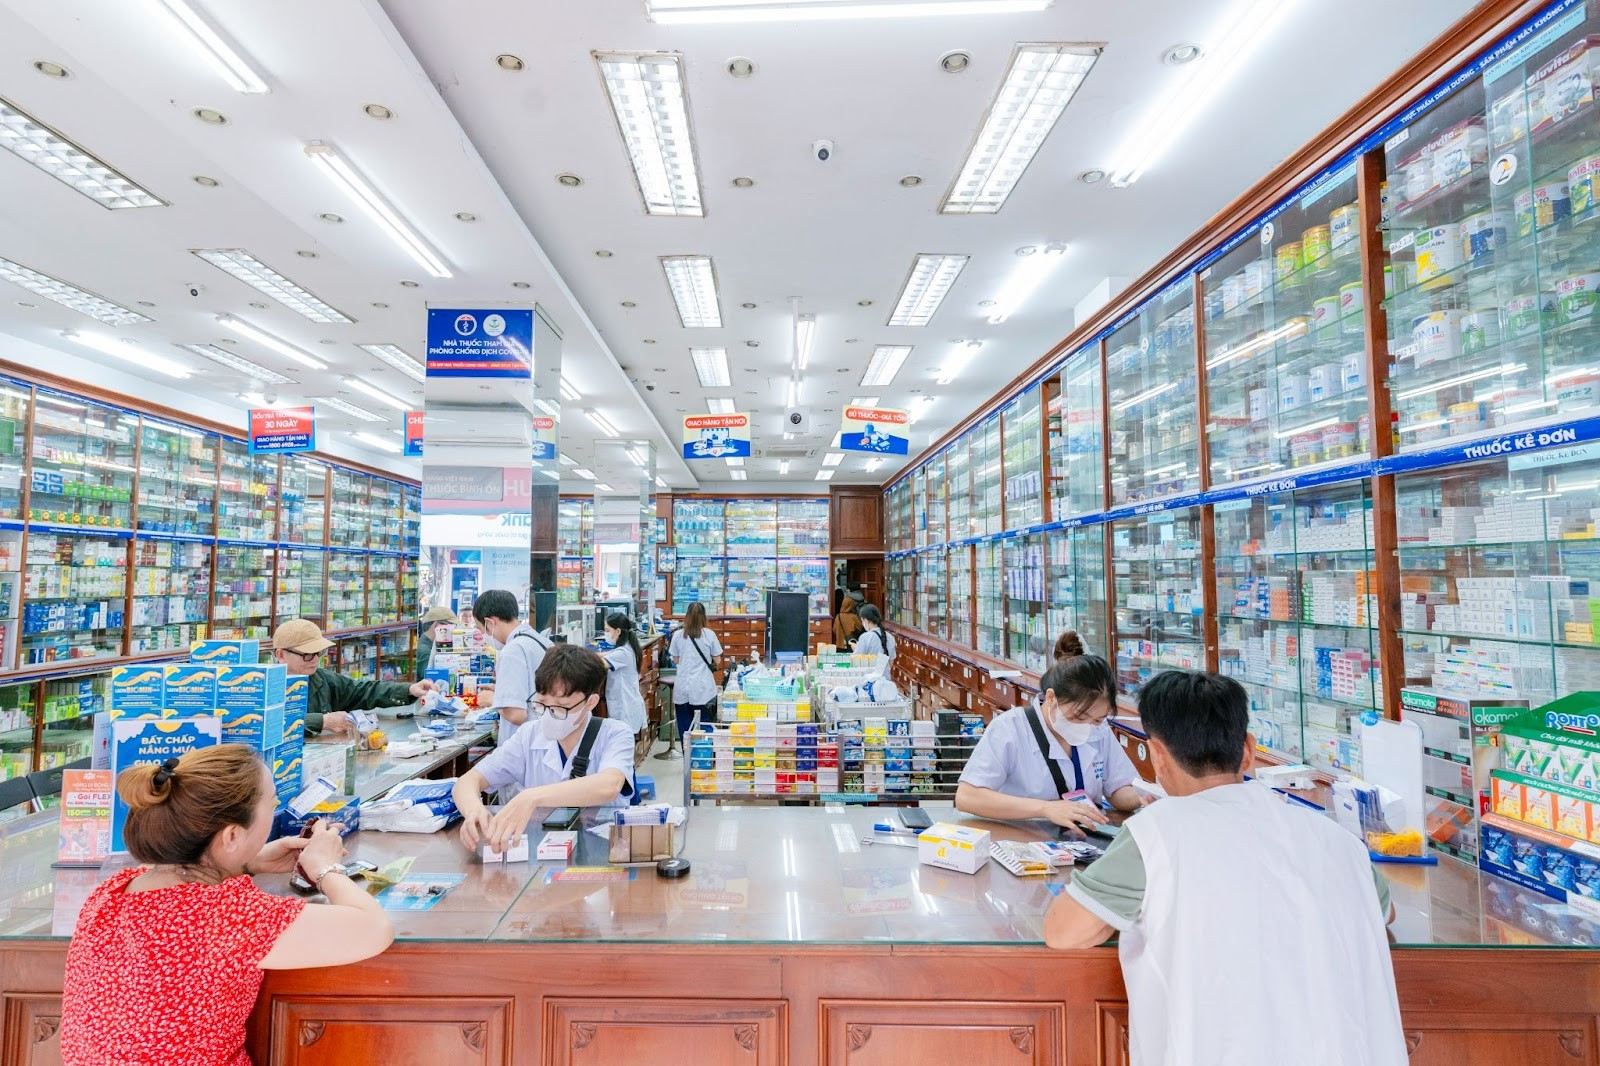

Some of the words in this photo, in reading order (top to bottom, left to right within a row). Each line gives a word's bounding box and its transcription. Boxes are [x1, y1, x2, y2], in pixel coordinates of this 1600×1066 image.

[1479, 55, 1495, 69] SẢN
[1495, 40, 1517, 58] PHẨM
[1517, 26, 1534, 41] NÀY
[1534, 7, 1564, 29] KHÔNG
[459, 338, 482, 347] THUỐC
[429, 347, 454, 355] PHÒNG
[455, 347, 480, 355] CHỐNG
[481, 348, 497, 356] DỊCH
[276, 418, 298, 428] NGÀY
[703, 418, 720, 426] HÀNG
[722, 417, 734, 427] TẬN
[1463, 437, 1512, 459] THUỐC
[1514, 434, 1536, 450] KÊ
[1538, 428, 1577, 446] ĐƠN
[423, 482, 458, 494] THUỐC
[460, 482, 483, 494] BÌNH
[1245, 483, 1267, 496] THUỐC
[1268, 481, 1279, 491] KÊ
[1279, 479, 1296, 490] ĐƠN
[1403, 693, 1436, 709] okamoto
[1545, 711, 1600, 730] ROHTO
[141, 734, 163, 744] BẤT
[165, 734, 196, 744] CHẤP
[1540, 732, 1555, 740] Cho
[138, 745, 170, 754] NẮNG
[172, 745, 197, 754] MƯA
